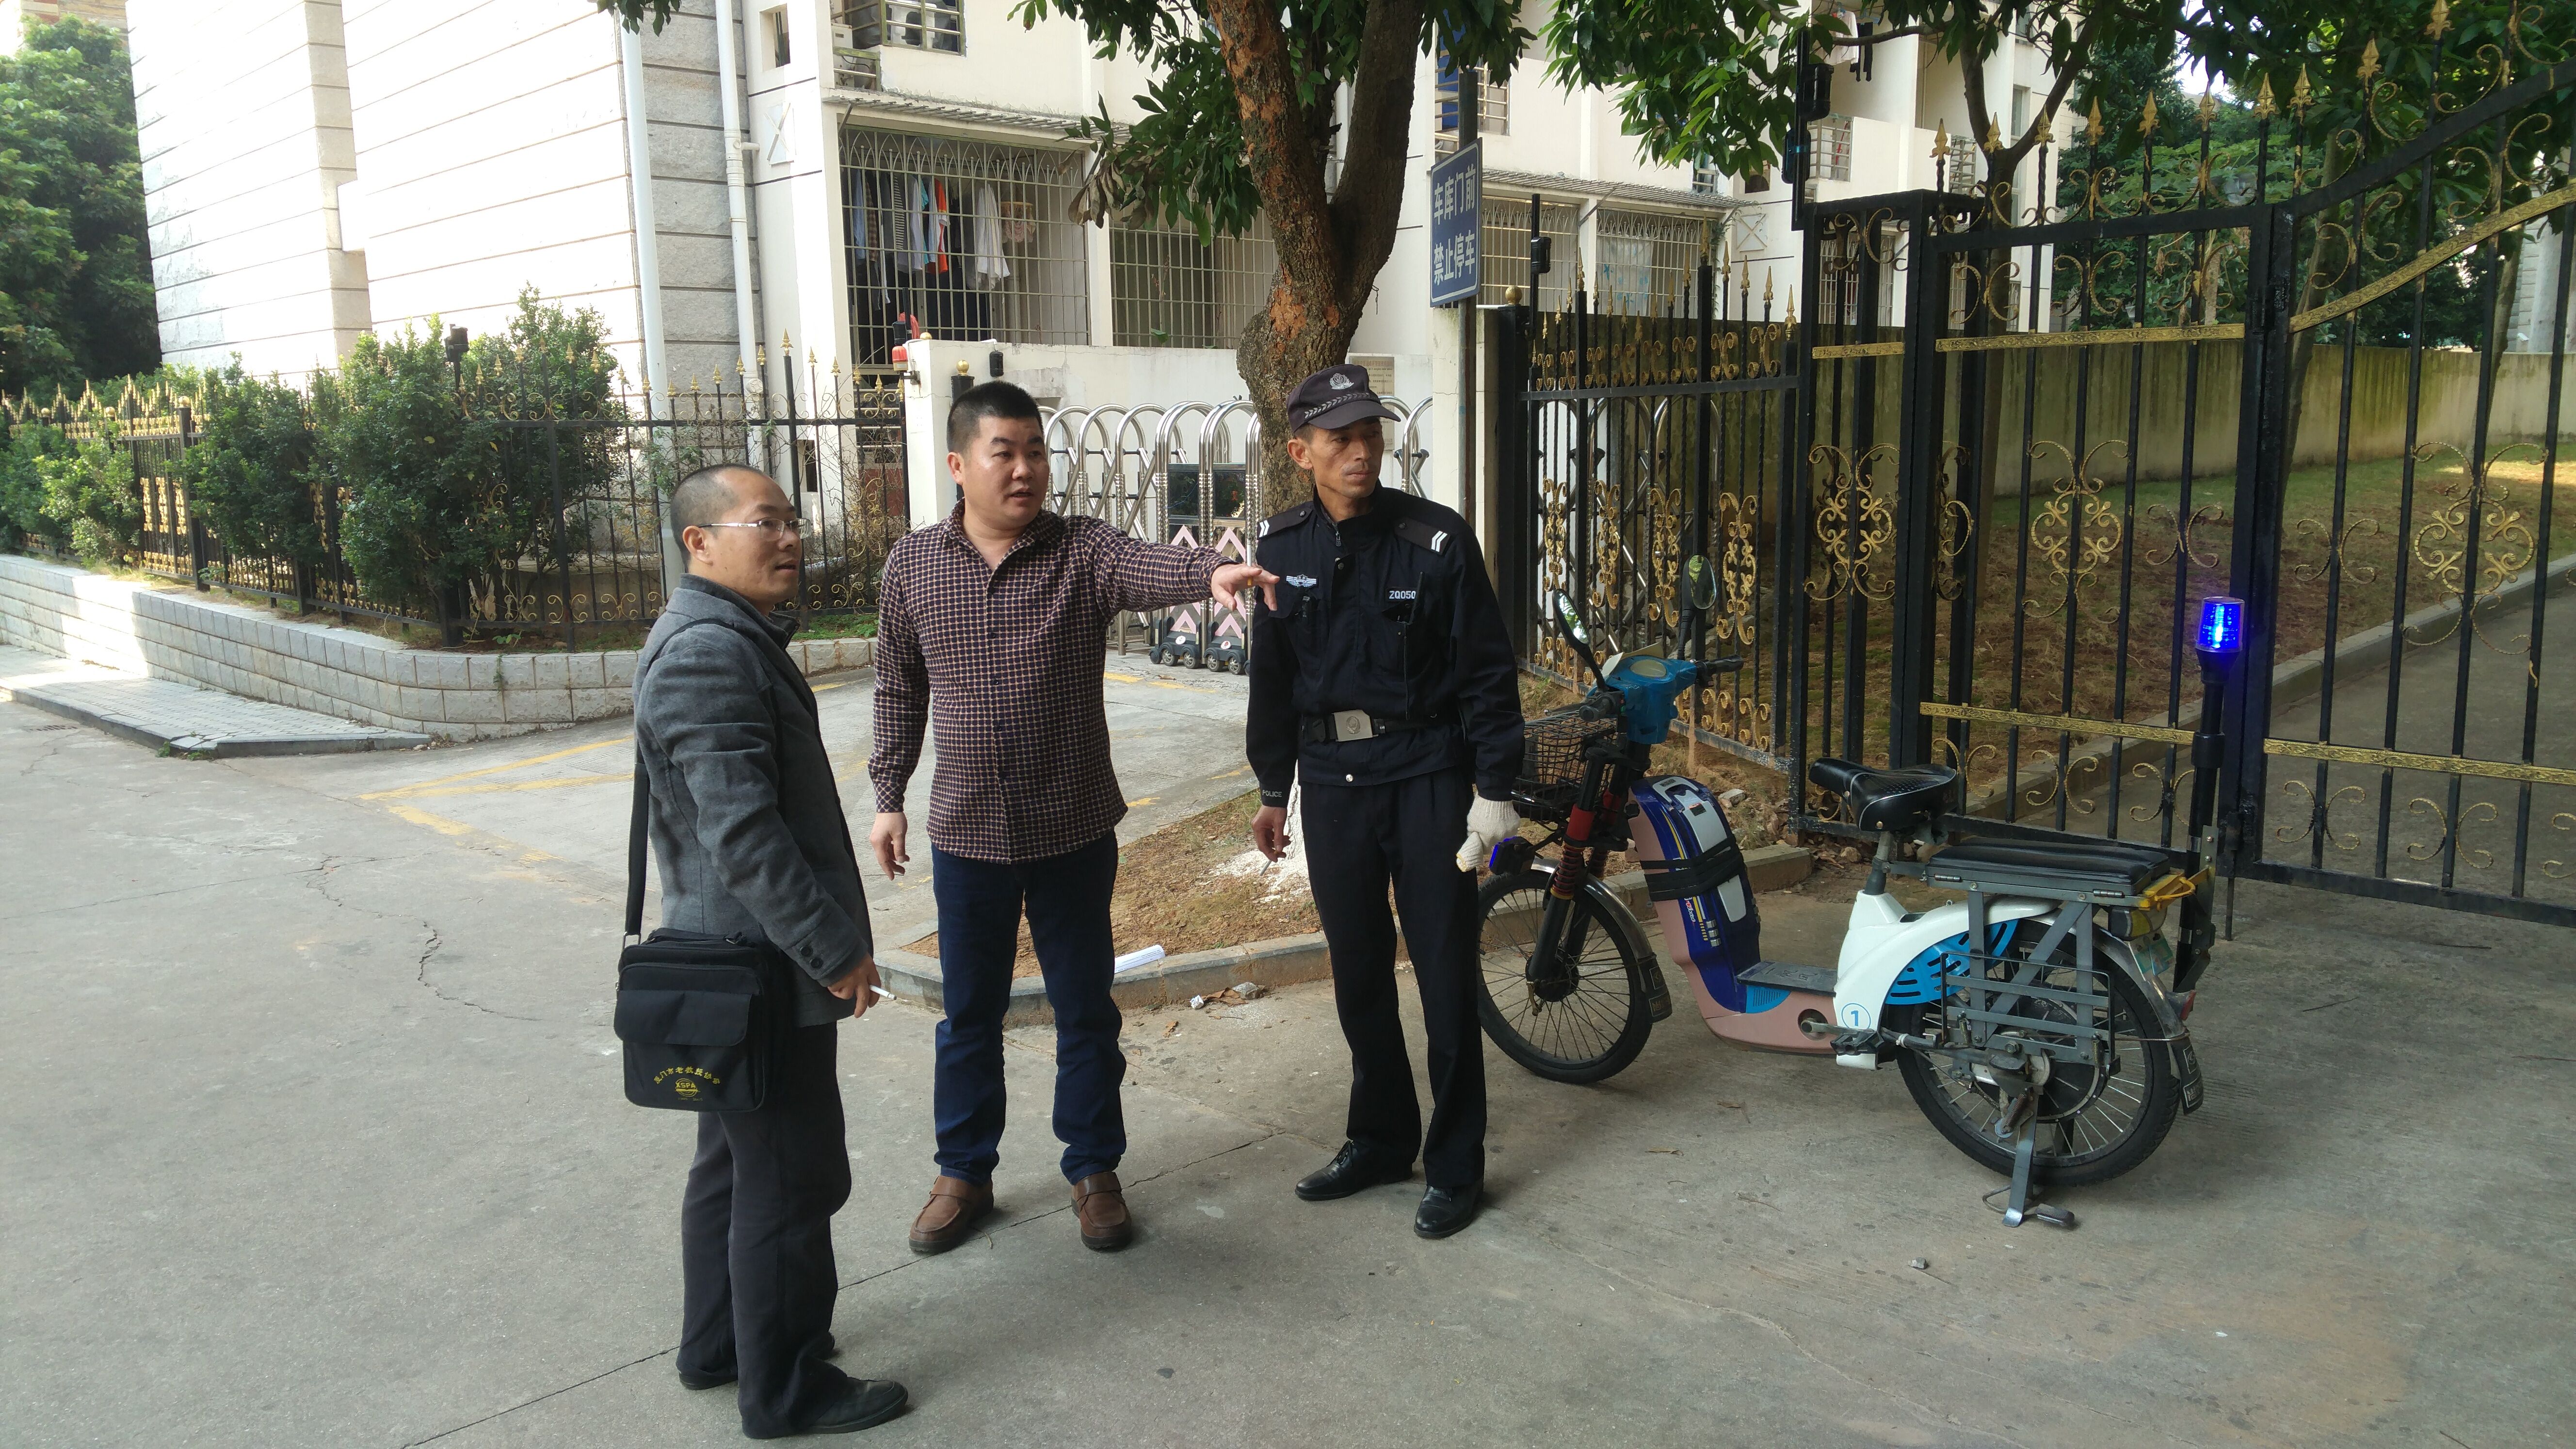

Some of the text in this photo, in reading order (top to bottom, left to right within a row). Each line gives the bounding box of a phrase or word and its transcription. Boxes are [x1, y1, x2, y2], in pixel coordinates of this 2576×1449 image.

[1434, 163, 1476, 225] 车库门前
[1434, 229, 1475, 285] 禁止停车
[1851, 1010, 1859, 1027] 1
